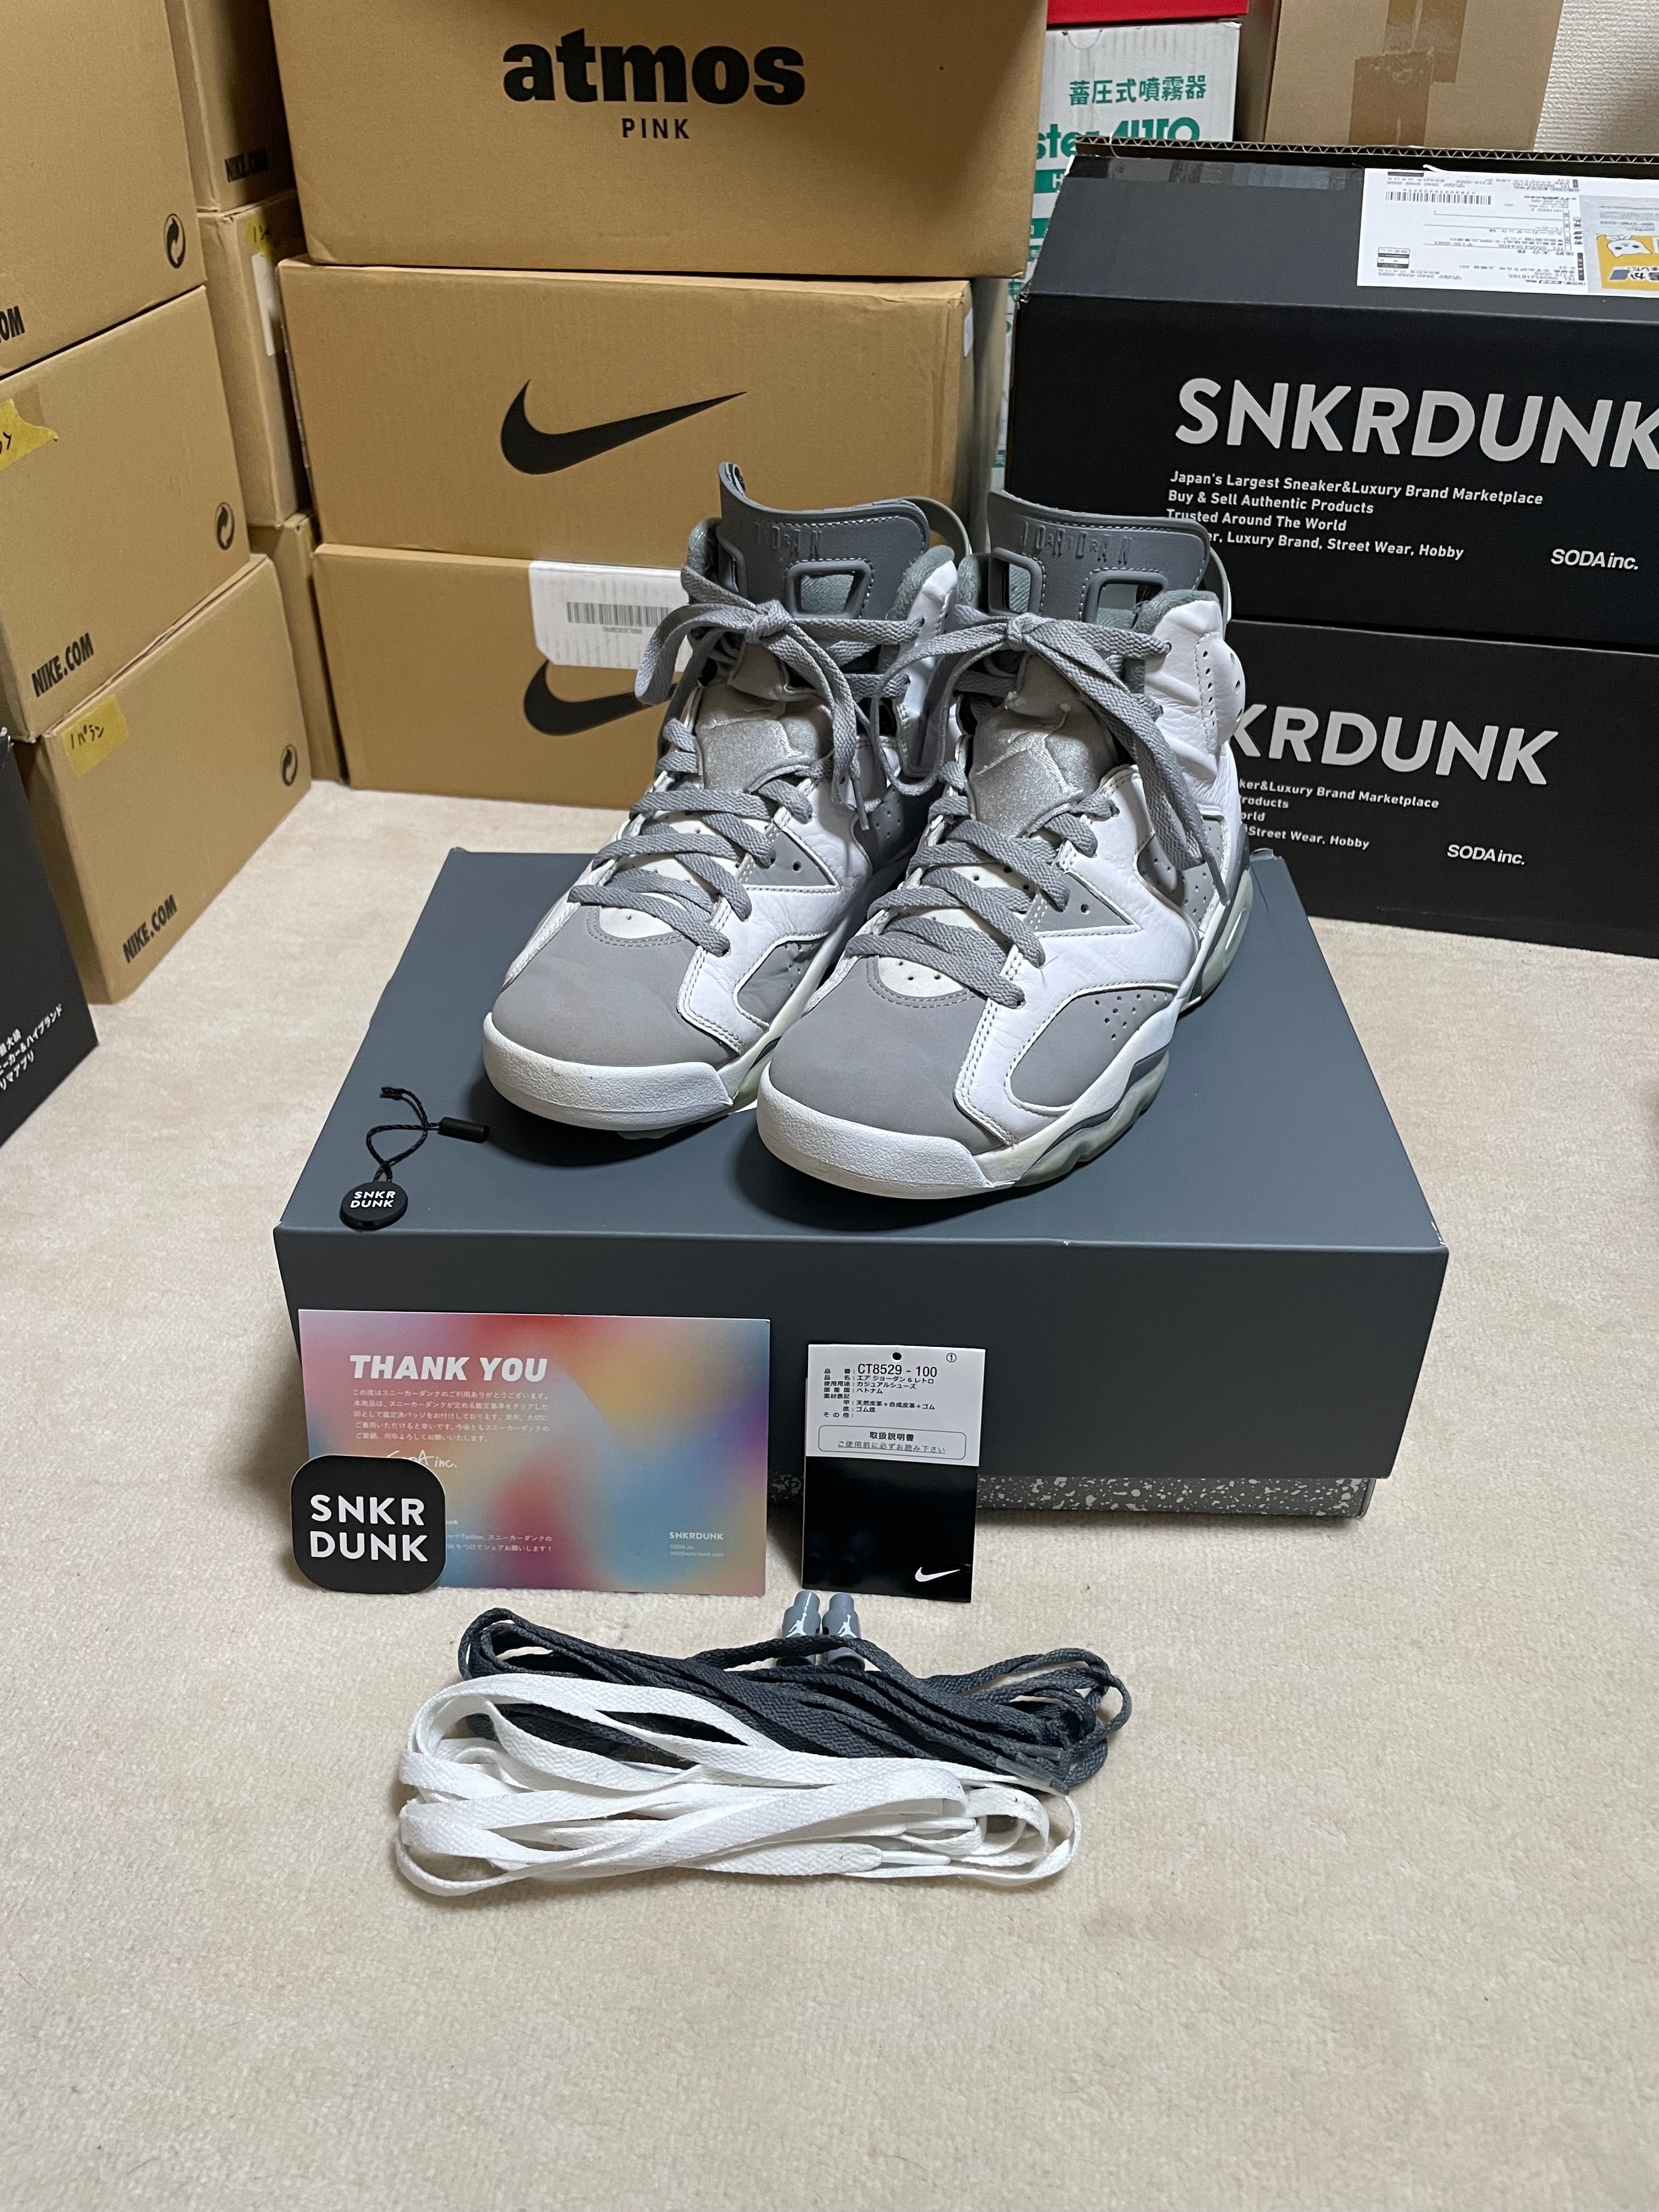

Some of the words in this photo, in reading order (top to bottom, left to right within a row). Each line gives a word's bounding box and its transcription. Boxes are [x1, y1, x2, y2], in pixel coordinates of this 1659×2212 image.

[503, 28, 805, 105] atmos
[1069, 75, 1206, 105] 蓄圧式噴霧器
[622, 118, 690, 139] PINK
[0, 306, 25, 343] OM
[1175, 377, 1659, 470] SNKRDUNK
[1170, 471, 1223, 486] Japan's
[1227, 474, 1280, 490] Largest
[1283, 477, 1402, 498] Sneaker&Luxury
[1406, 484, 1449, 499] Brand
[1453, 488, 1543, 505] Marketplace
[1168, 489, 1194, 505] Buy
[1197, 492, 1207, 504] &
[1211, 492, 1238, 505] Sell
[1241, 494, 1308, 510] Authentic
[1311, 499, 1374, 514] Products
[1166, 508, 1219, 523] Trusted
[1222, 512, 1272, 527] Around
[1276, 516, 1301, 528] The
[1305, 517, 1347, 532] World
[1227, 531, 1275, 548] Luxury
[1278, 535, 1323, 550] Brand,
[1327, 538, 1370, 552] Street
[1375, 541, 1414, 556] Wear,
[1419, 544, 1464, 561] Hobby
[31, 633, 94, 697] NIKE.COM
[1240, 795, 1289, 809] roducts
[1317, 786, 1356, 800] Brand
[1358, 791, 1440, 809] Marketplace
[1248, 825, 1286, 840] Street
[1329, 835, 1370, 851] Hobby
[122, 894, 178, 963] NIKE.COM
[350, 1200, 394, 1208] DUNK
[354, 1190, 396, 1199] SNKR
[350, 1355, 470, 1380] THANK
[479, 1357, 548, 1383] YOU
[858, 1363, 902, 1375] CT8529
[916, 1366, 937, 1378] 100
[857, 1381, 916, 1390] カジュアルシューズ
[838, 1441, 946, 1453] ご使用前に必ずお読み下さい
[869, 1431, 914, 1442] 取扱説明書
[311, 1493, 425, 1526] SNKR
[309, 1530, 428, 1562] DUNK
[669, 1531, 724, 1541] SNKRDUNK
